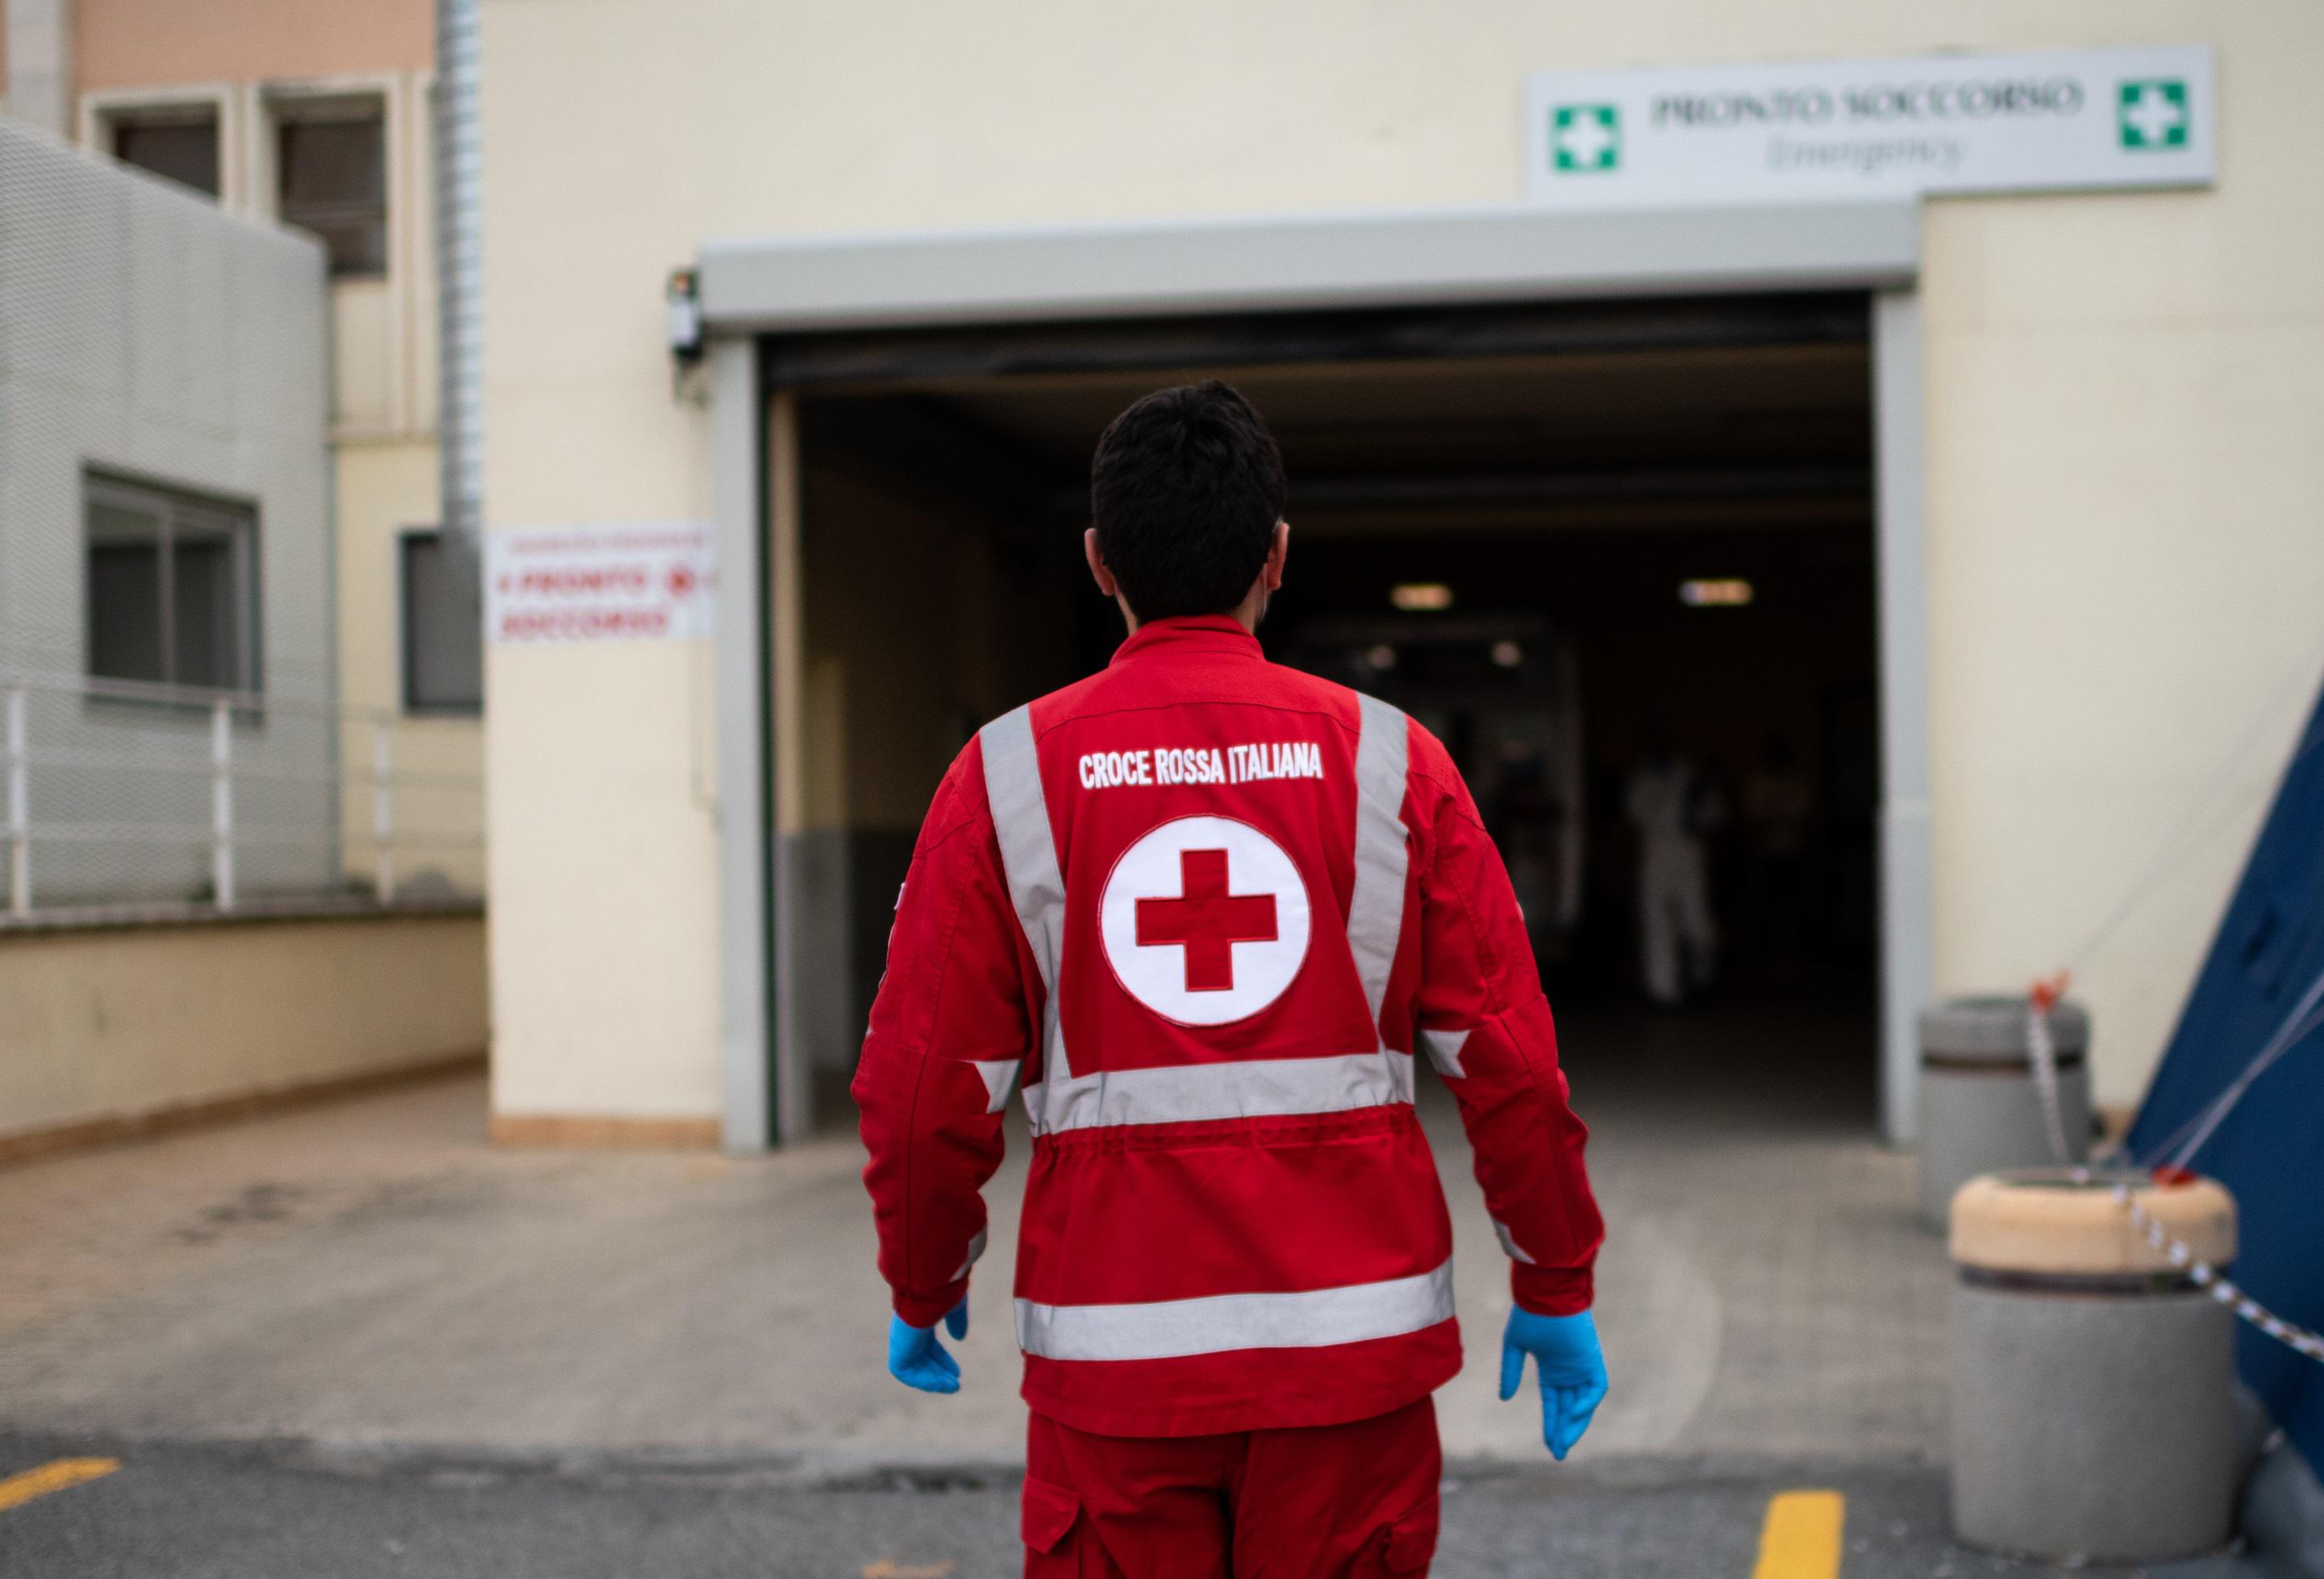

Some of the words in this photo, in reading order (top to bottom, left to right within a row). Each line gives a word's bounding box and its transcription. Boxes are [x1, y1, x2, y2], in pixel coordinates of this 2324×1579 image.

[1651, 85, 1833, 129] PRONTO
[1841, 75, 2085, 123] SOCCORSO
[1768, 131, 1966, 174] Emergency
[519, 567, 648, 596] PRONTO
[502, 610, 669, 638] SOCCORSO
[1079, 751, 1152, 790] CROCE
[1154, 748, 1226, 785] ROSSA
[1227, 742, 1323, 785] ITALIANA
